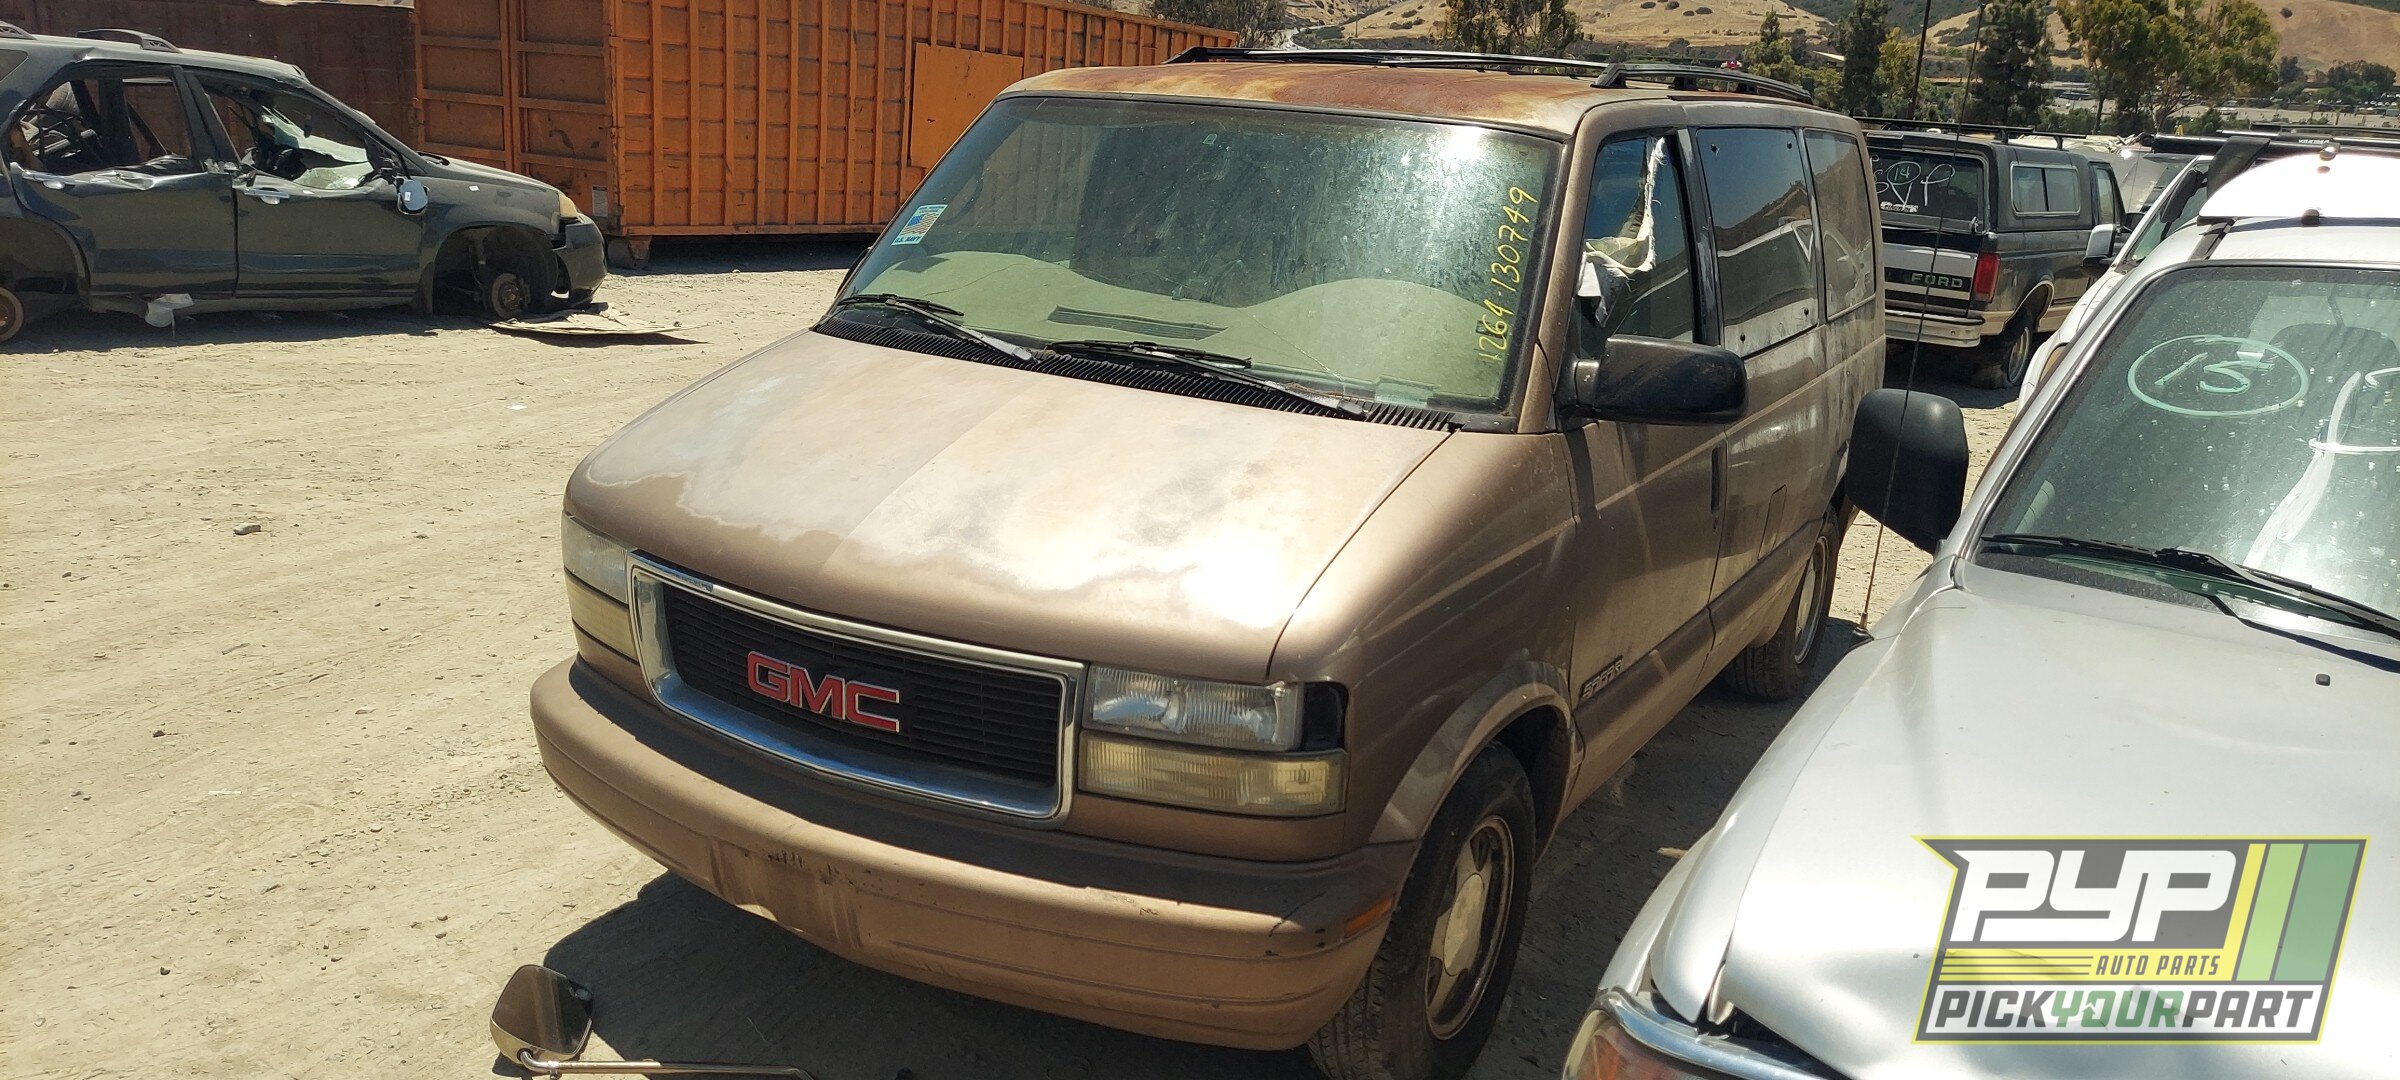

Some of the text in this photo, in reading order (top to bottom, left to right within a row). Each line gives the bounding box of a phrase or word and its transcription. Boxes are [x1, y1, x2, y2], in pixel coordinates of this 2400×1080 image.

[1911, 272, 1963, 288] FORD
[2154, 352, 2275, 393] 15
[747, 651, 899, 733] GMC
